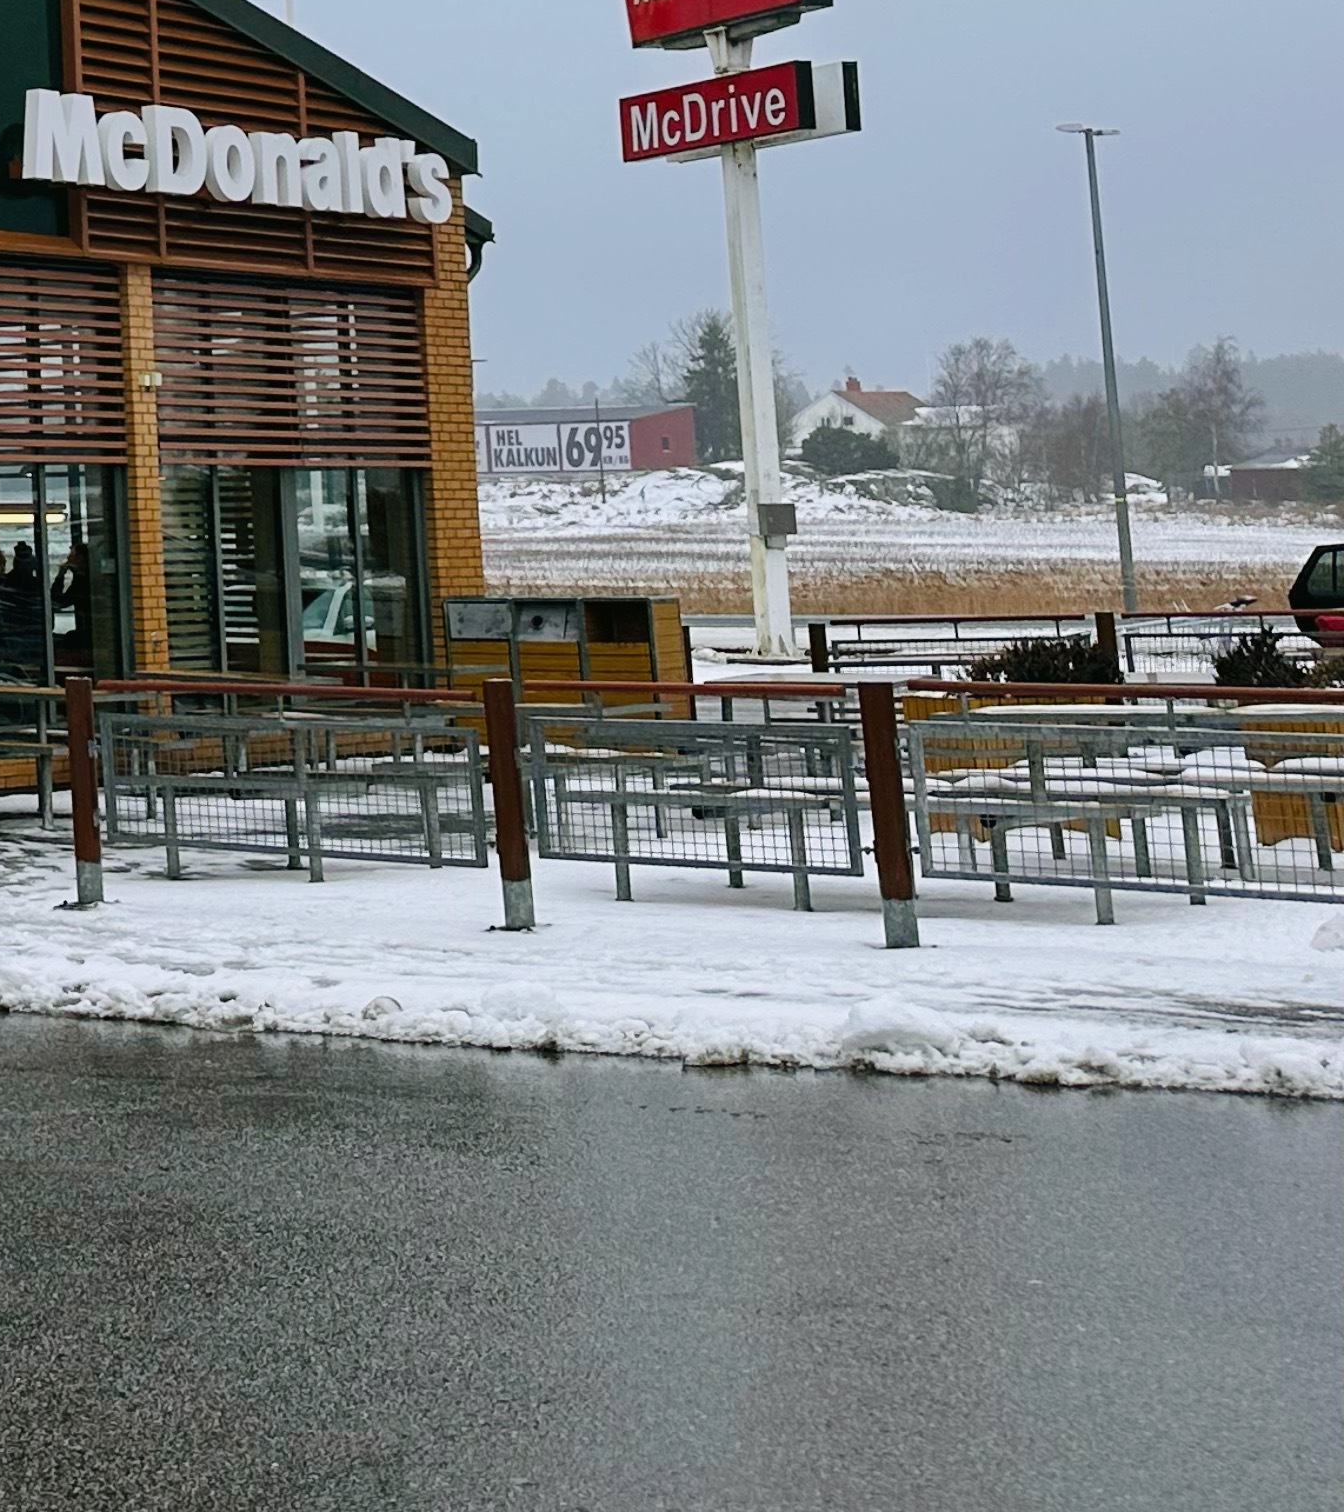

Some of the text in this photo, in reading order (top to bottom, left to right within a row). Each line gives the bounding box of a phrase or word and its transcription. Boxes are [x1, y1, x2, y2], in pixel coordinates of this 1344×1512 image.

[629, 84, 787, 153] McDrive
[21, 88, 453, 225] McDonald's
[493, 446, 558, 468] KALKUN
[496, 429, 523, 447] HEL
[565, 425, 626, 468] 69 95
